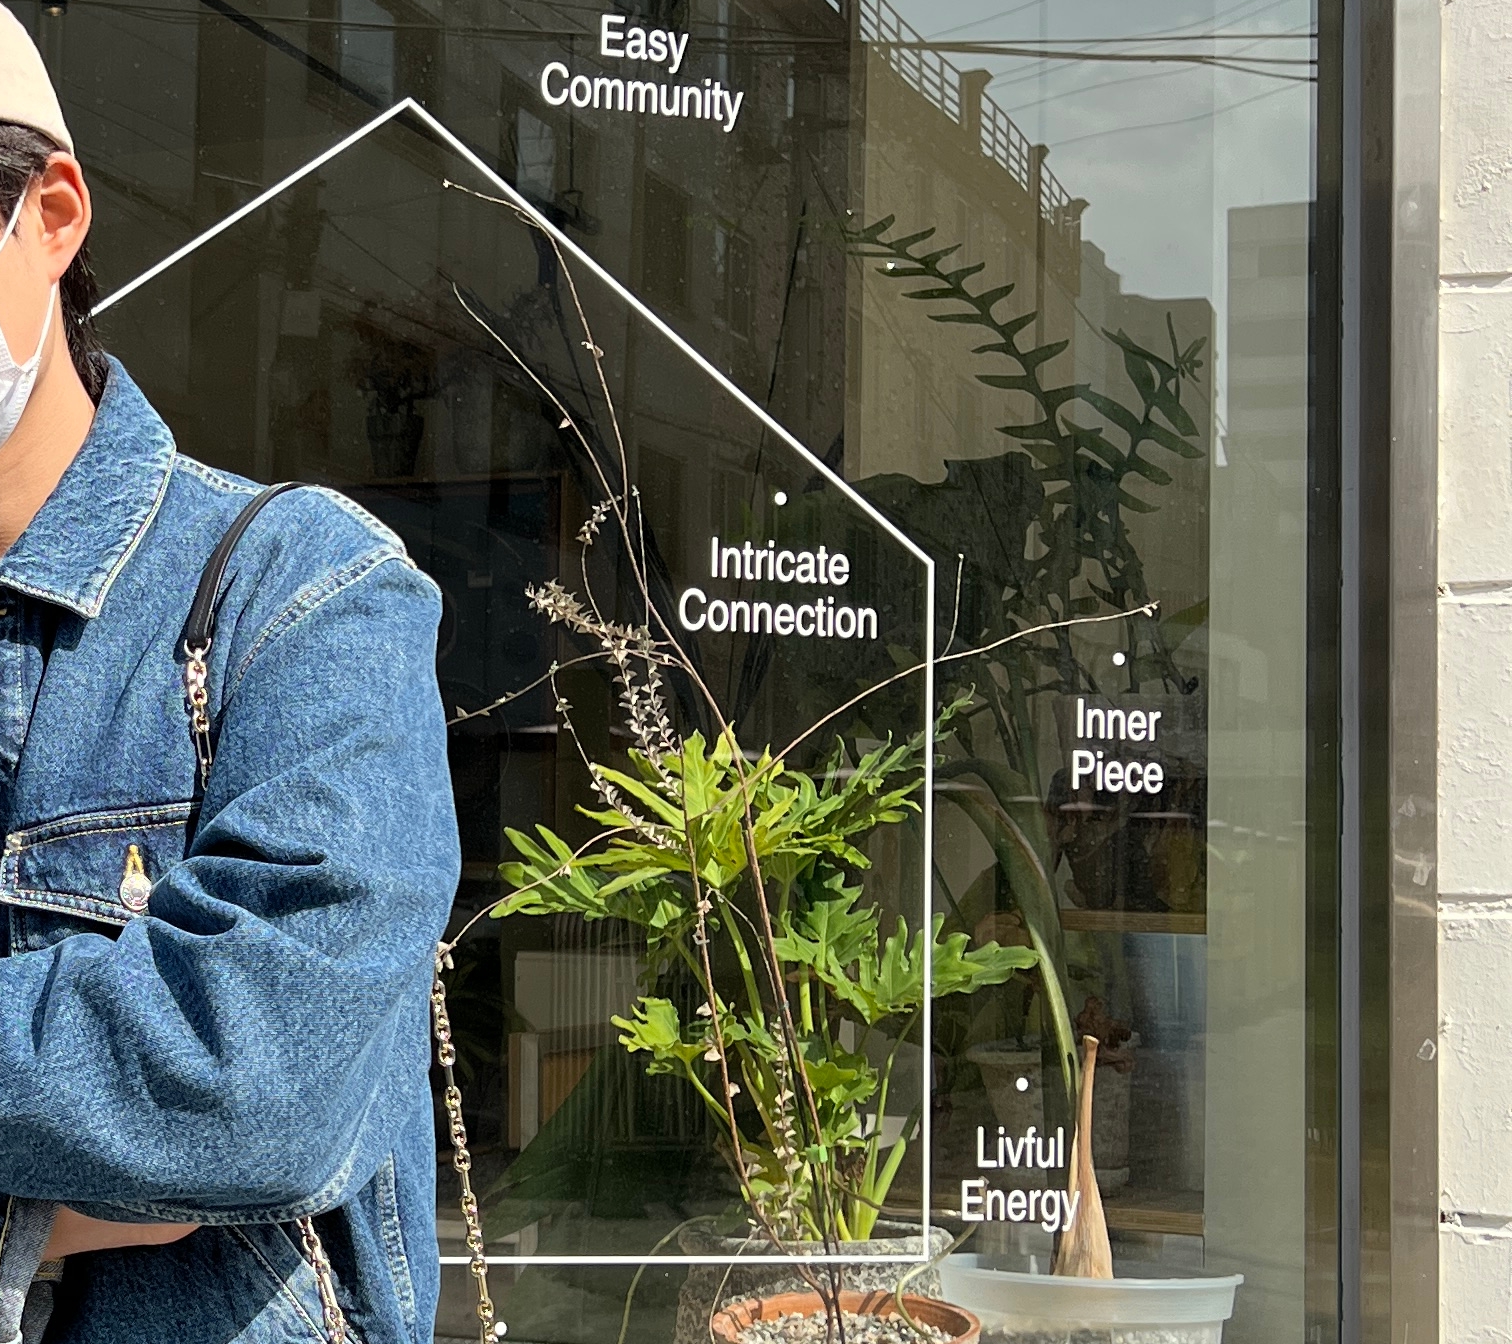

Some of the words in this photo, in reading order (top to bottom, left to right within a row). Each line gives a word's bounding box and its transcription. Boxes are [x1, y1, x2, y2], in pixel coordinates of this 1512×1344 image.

[601, 14, 689, 74] Easy
[541, 62, 744, 133] Community
[711, 536, 850, 585] Intricate
[679, 587, 877, 639] Connection
[1076, 698, 1161, 741] Inner
[1072, 749, 1164, 794] Piece
[977, 1126, 1064, 1169] Livful
[962, 1179, 1080, 1233] Energy
